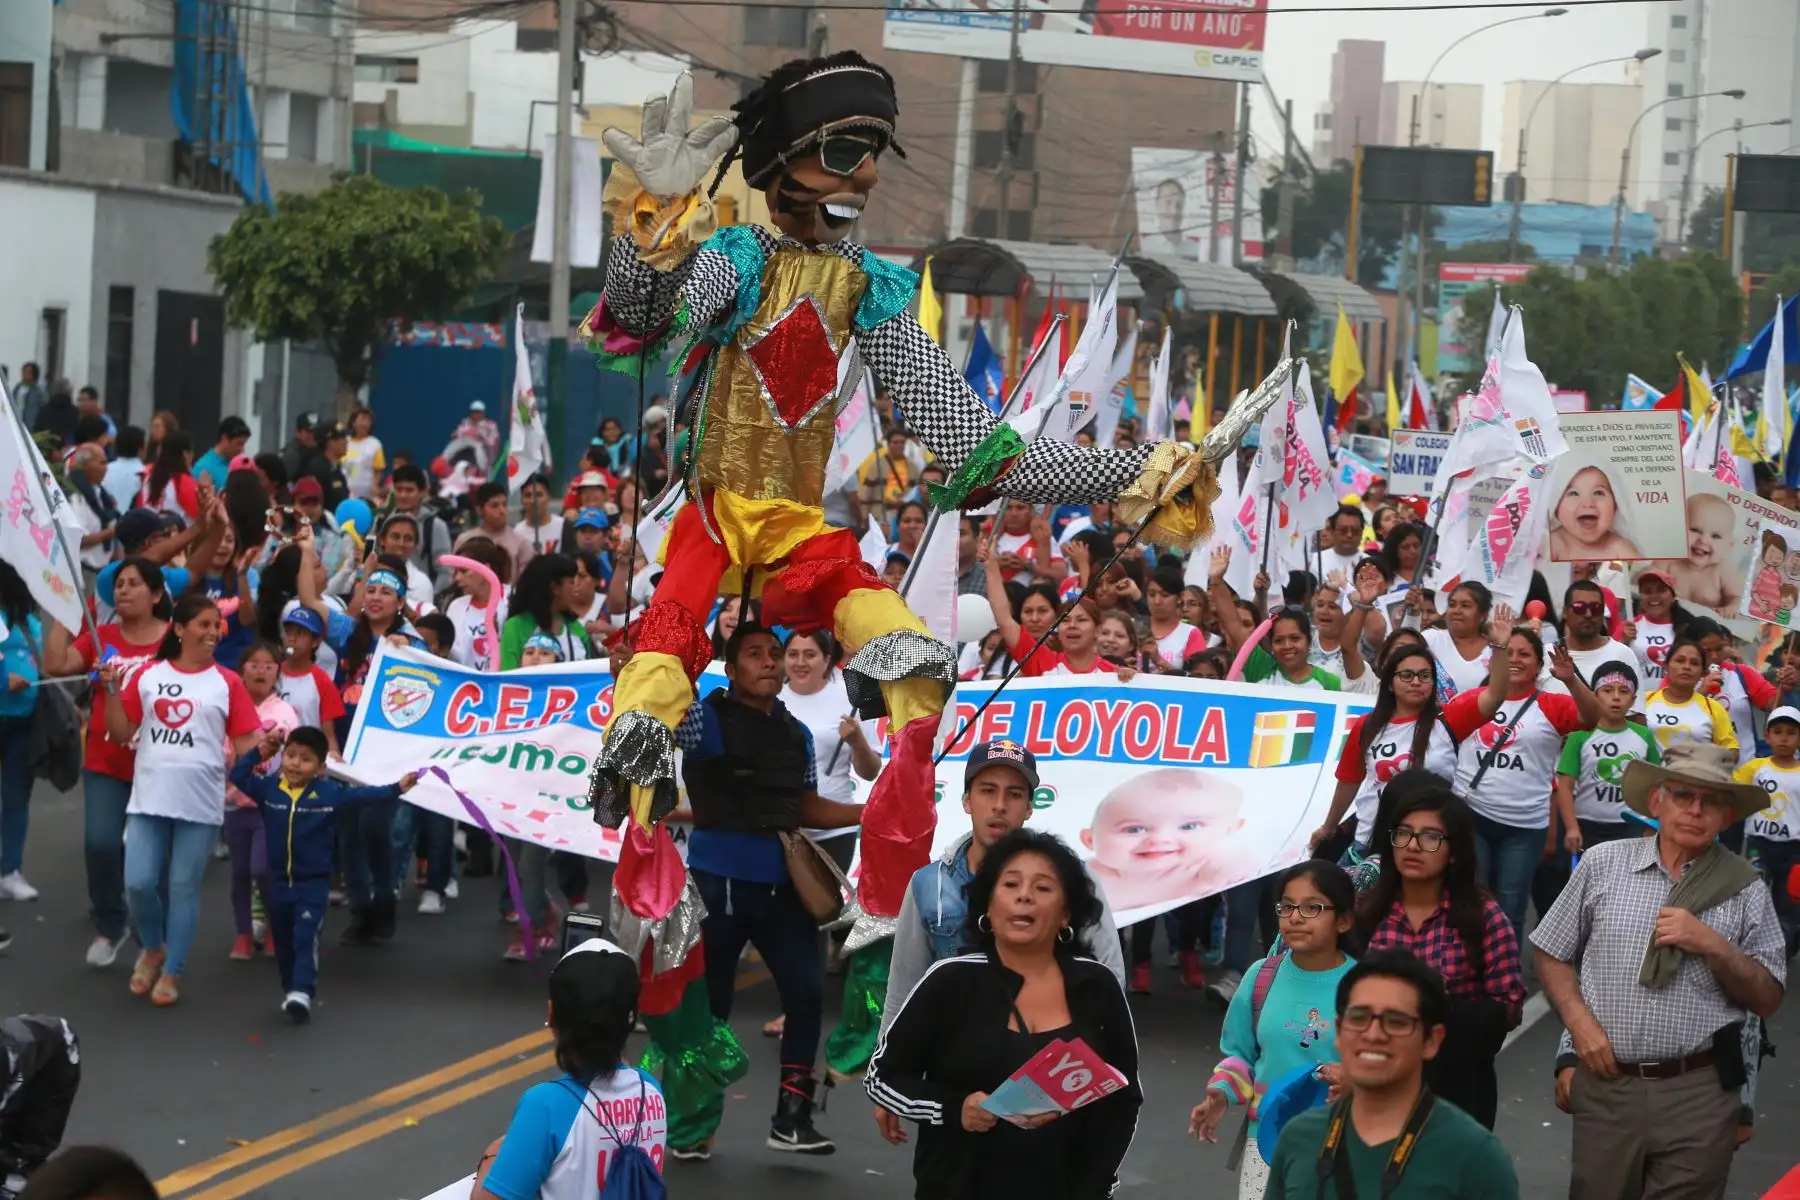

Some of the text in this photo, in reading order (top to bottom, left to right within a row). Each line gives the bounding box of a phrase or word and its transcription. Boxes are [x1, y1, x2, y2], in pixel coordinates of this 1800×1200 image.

[1126, 4, 1163, 29] POR
[1170, 10, 1196, 32] UN
[1212, 54, 1259, 68] CAPAC
[1635, 423, 1673, 431] PRIVILEGIO
[1415, 437, 1449, 449] COLEGIO
[1575, 435, 1584, 443] DE
[1587, 434, 1608, 442] ESTAR
[1393, 452, 1415, 474] SAN
[1646, 465, 1675, 473] DEFENSA
[1636, 491, 1669, 504] VIDA
[1727, 492, 1798, 529] YO DEFIENDO
[1746, 517, 1759, 530] LA
[1646, 636, 1665, 645] YO
[157, 682, 183, 698] YO
[444, 681, 578, 737] C.E.P.
[1656, 713, 1679, 726] YO
[149, 727, 194, 748] VIDA
[1025, 698, 1230, 764] LOYOLA
[1370, 742, 1397, 760] YO
[1591, 742, 1619, 757] YO
[1757, 779, 1778, 793] YO
[1594, 786, 1624, 803] VID
[1753, 819, 1790, 838] VIDA
[595, 1094, 665, 1127] MARCHA
[641, 1126, 653, 1142] LA
